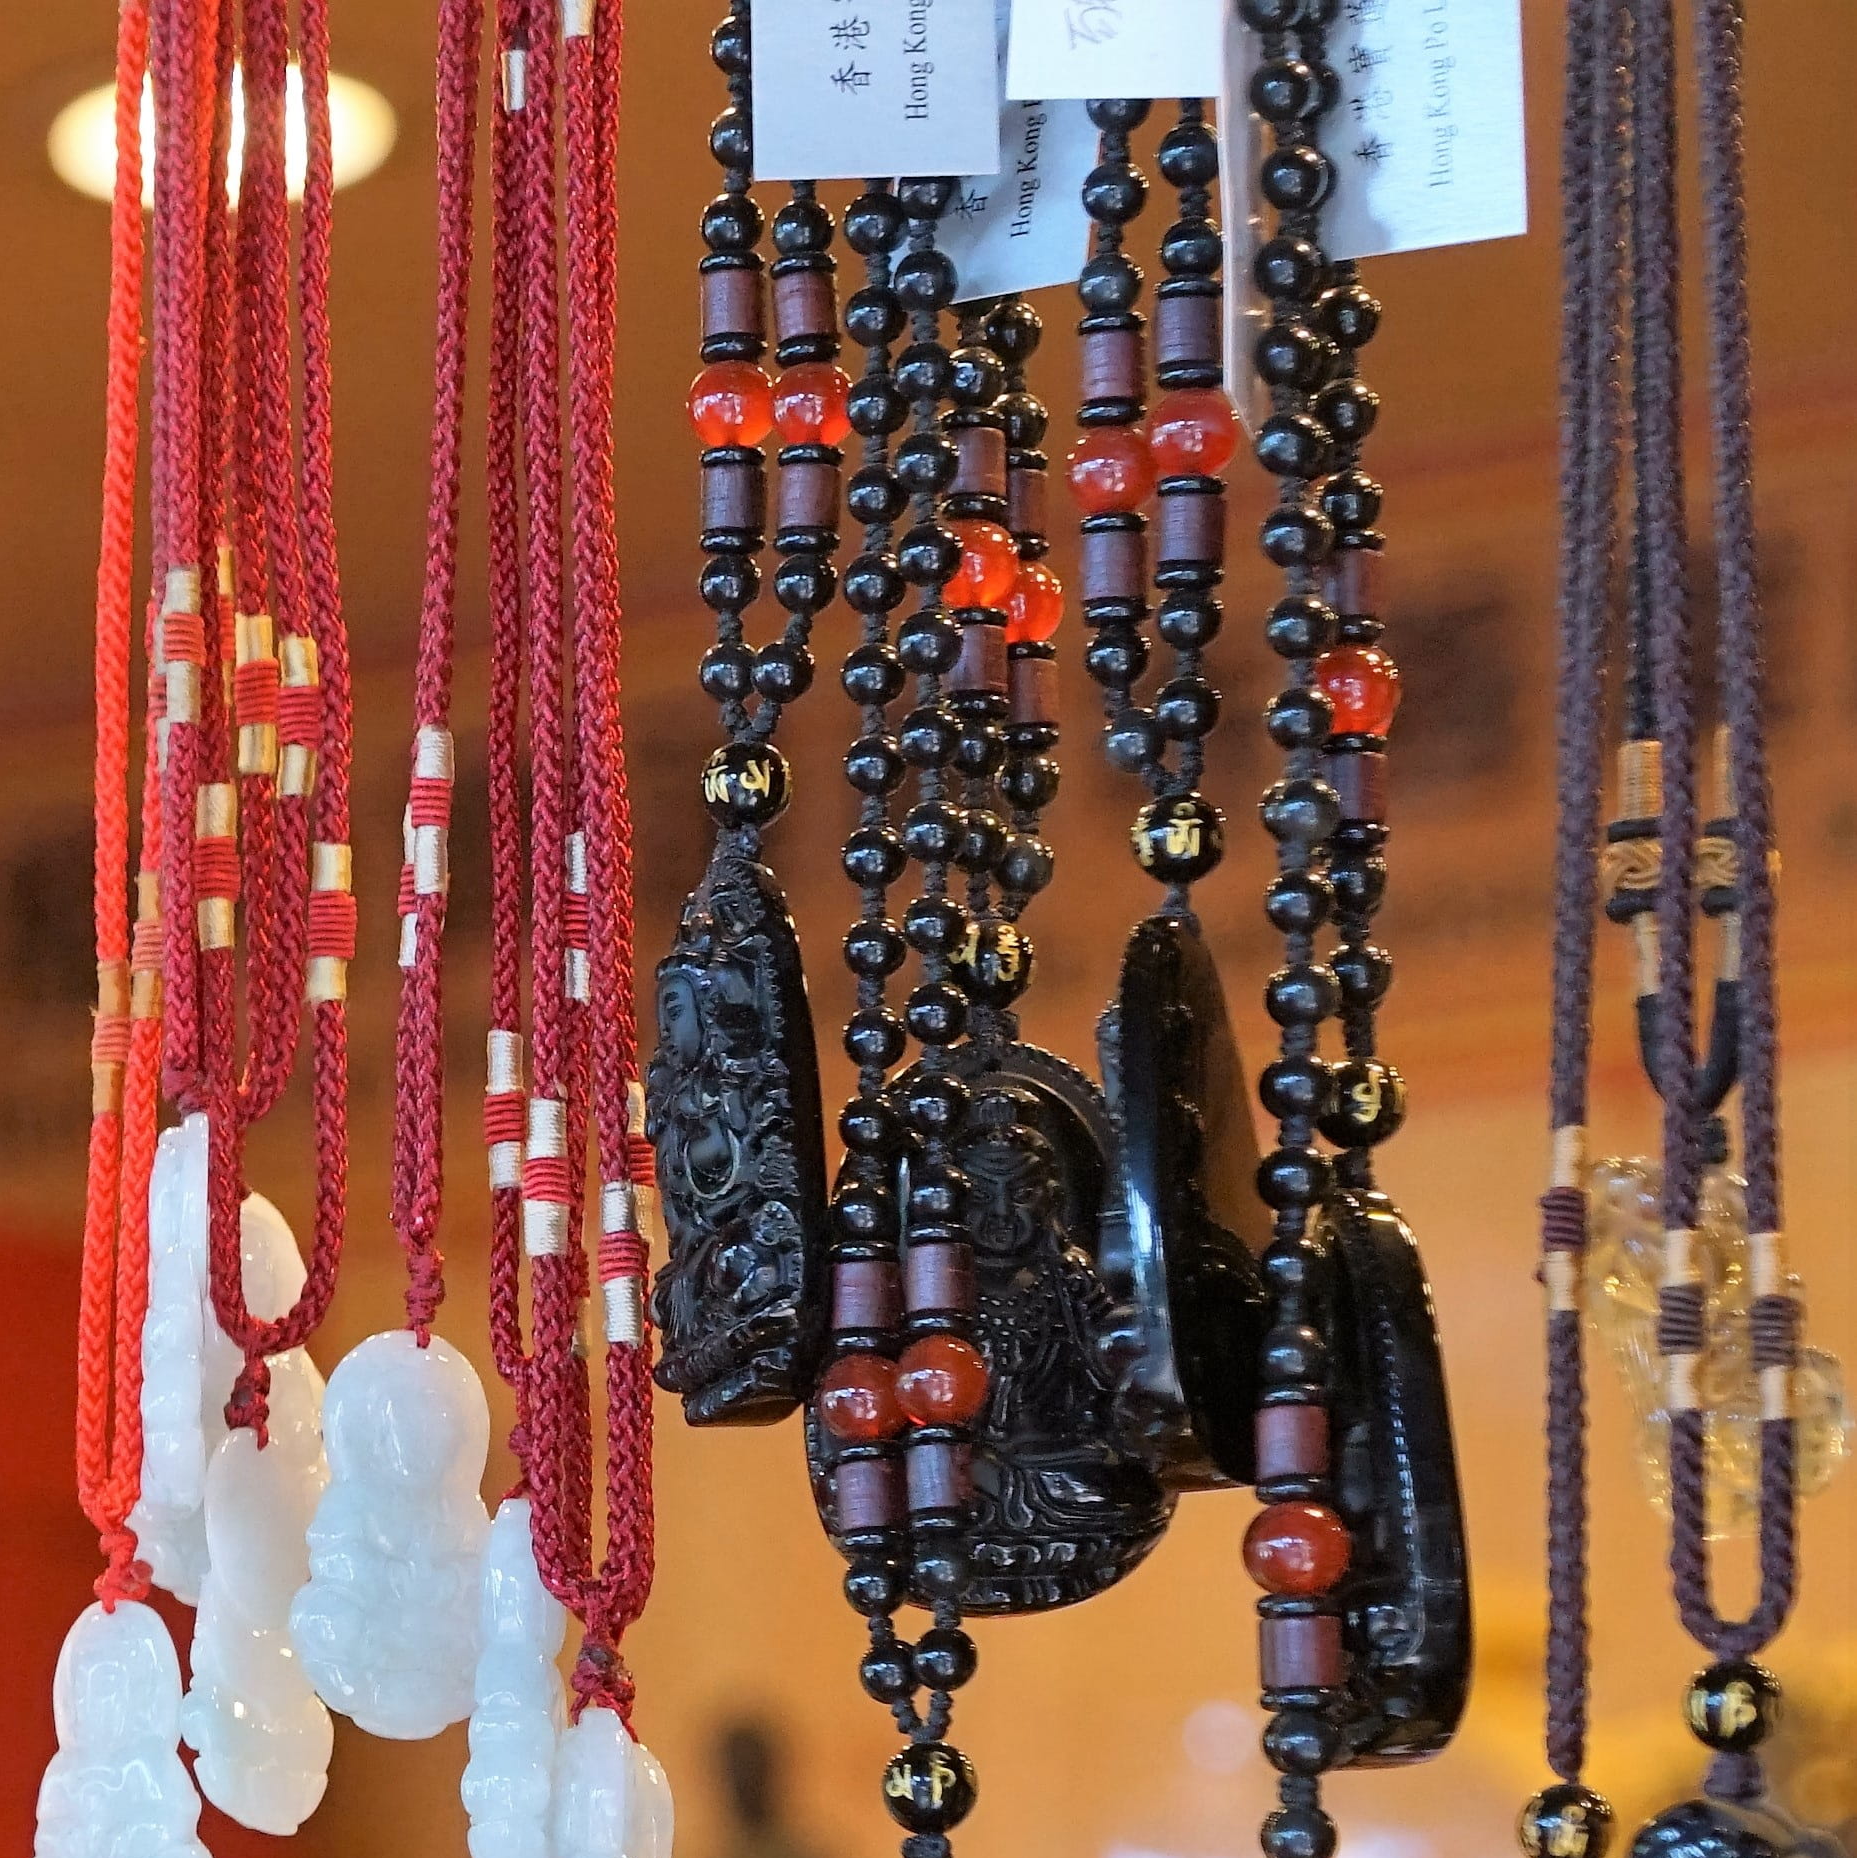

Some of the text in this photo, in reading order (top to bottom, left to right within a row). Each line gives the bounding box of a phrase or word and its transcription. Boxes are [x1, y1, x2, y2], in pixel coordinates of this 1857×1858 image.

[902, 0, 935, 120] Hong Kong
[1424, 20, 1448, 49] Po
[1422, 55, 1456, 120] Kong
[1016, 112, 1048, 175] Kong
[1428, 124, 1459, 188] Hong
[954, 188, 988, 225] 香
[1009, 177, 1042, 238] Hong
